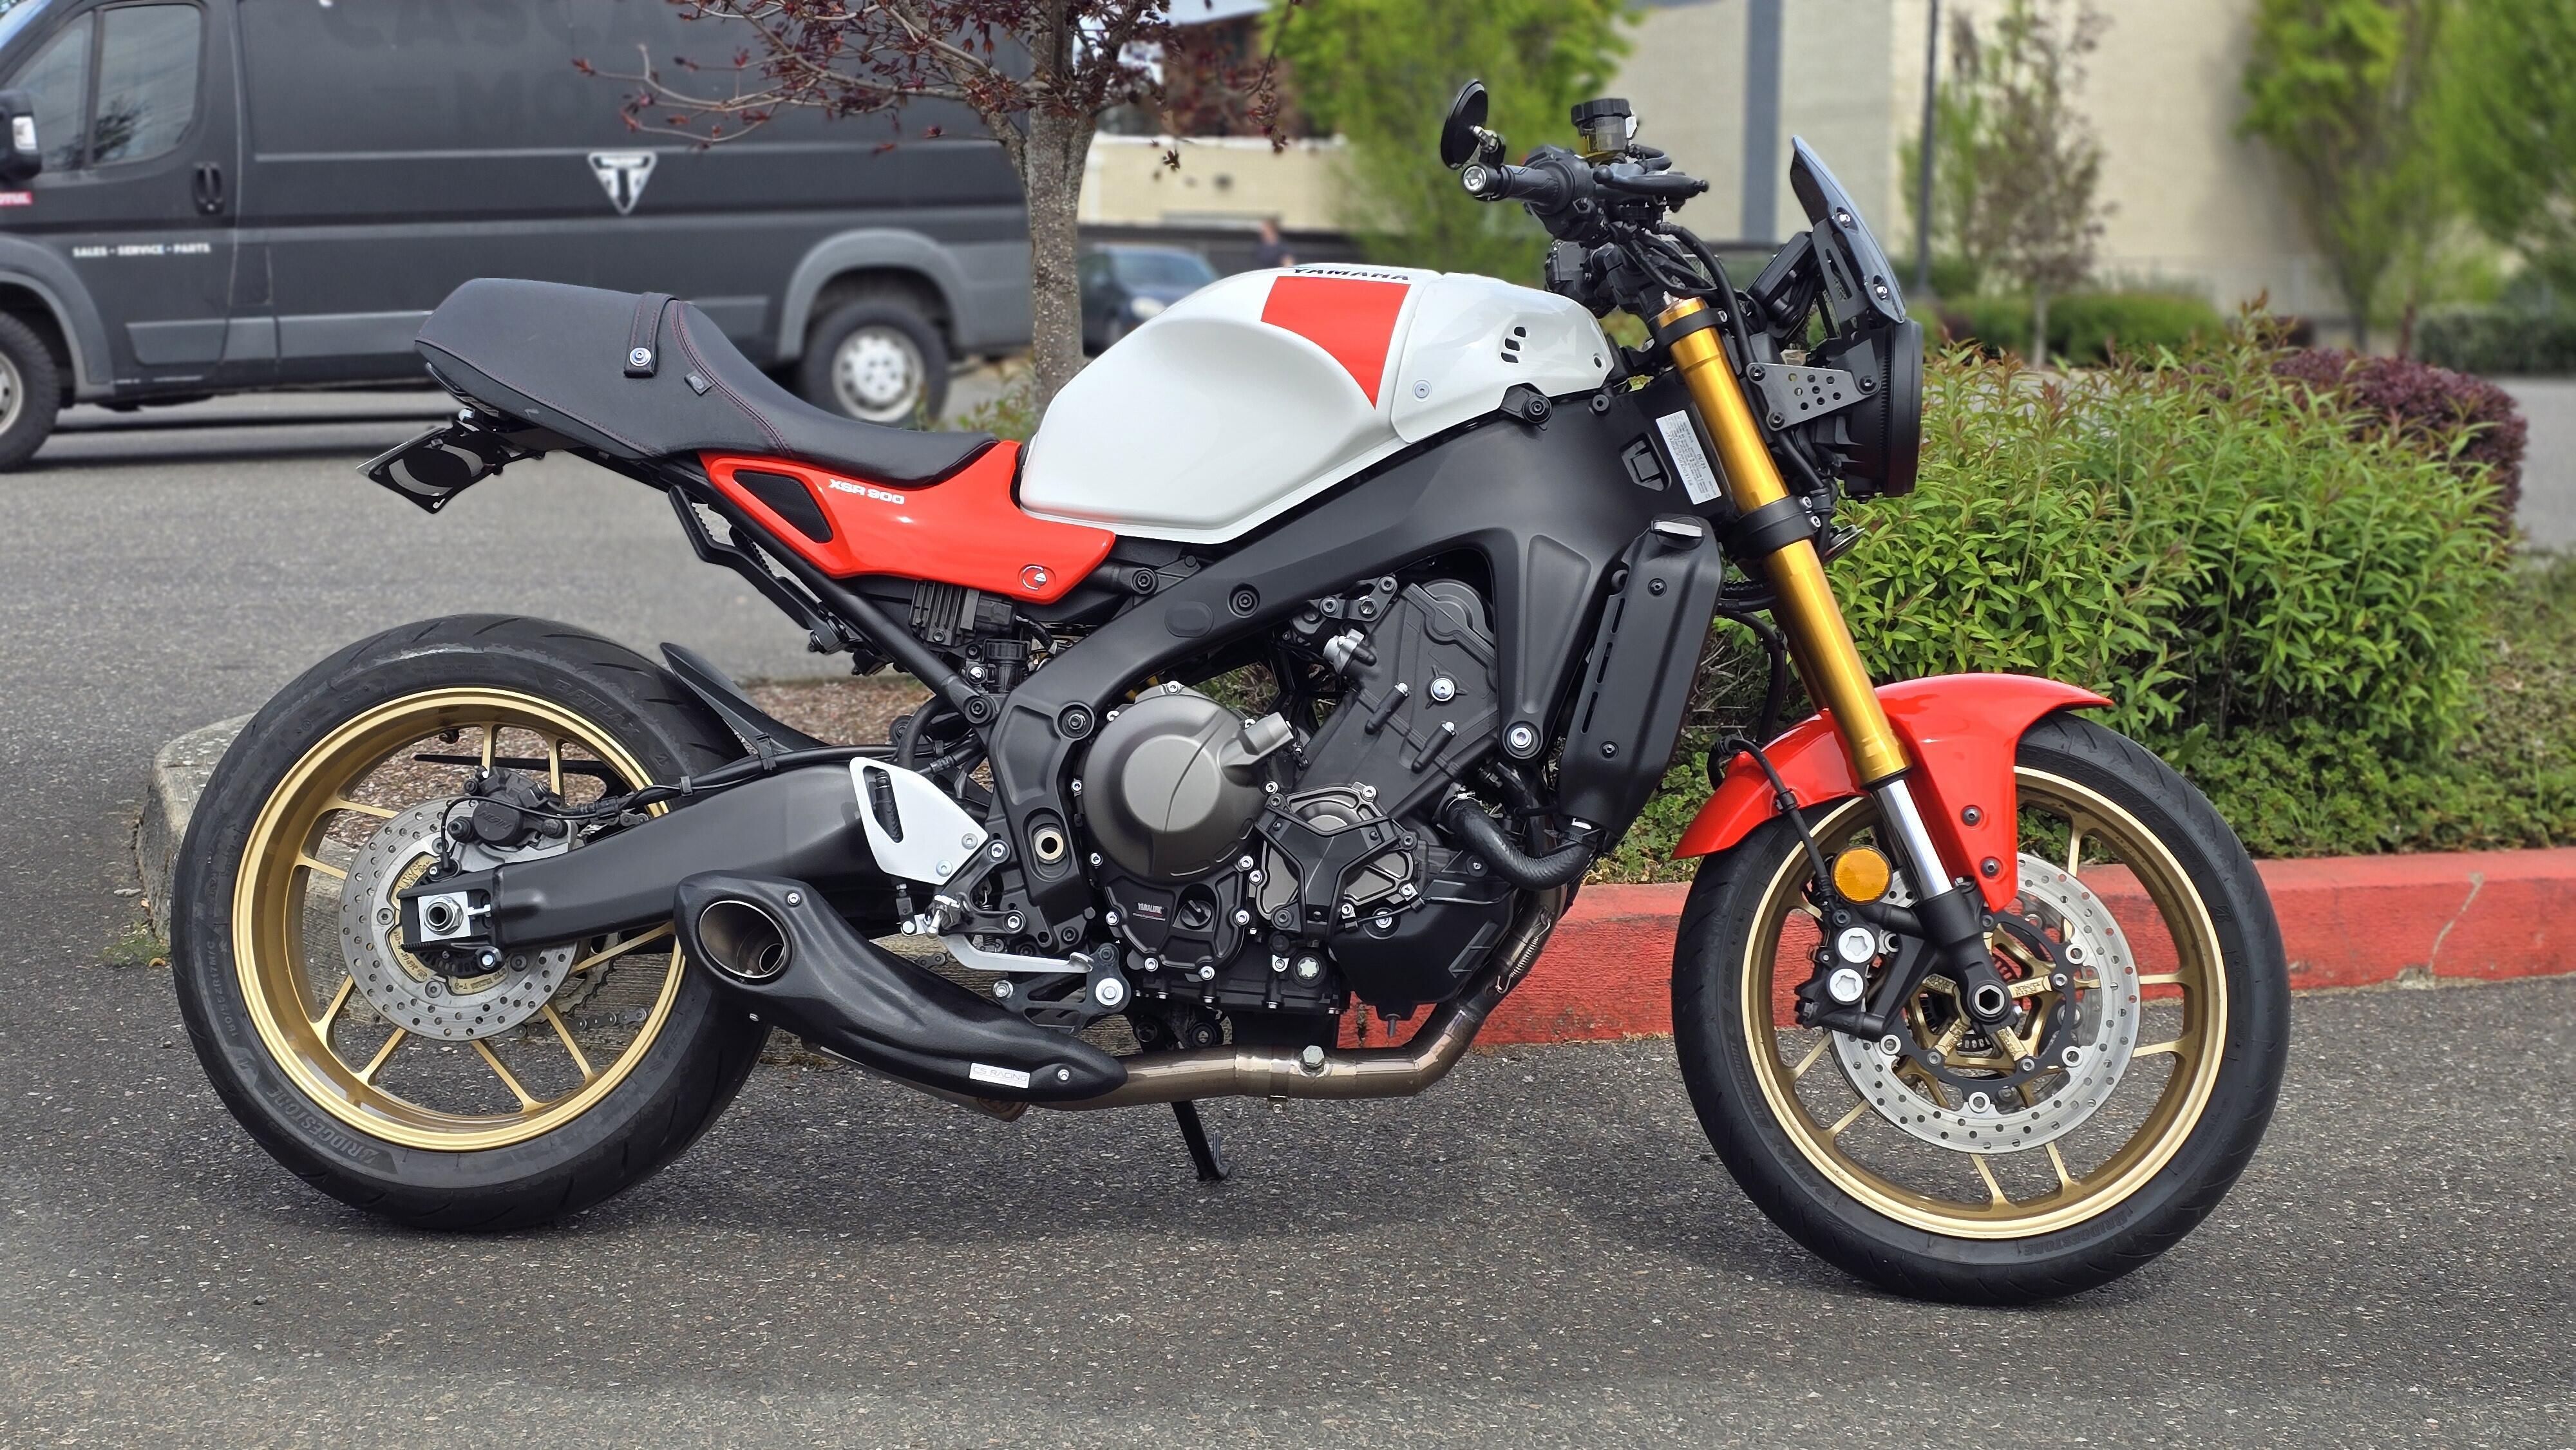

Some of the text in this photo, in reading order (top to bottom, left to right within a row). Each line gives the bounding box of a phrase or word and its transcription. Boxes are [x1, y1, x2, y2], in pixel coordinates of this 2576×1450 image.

[73, 243, 211, 257] SALES SERVICE PARTS
[1294, 268, 1408, 281] YAMAHA
[828, 478, 905, 505] XSR 900
[990, 1069, 1027, 1082] RACING
[266, 1086, 379, 1165] BRIDGESTONE
[2023, 1210, 2129, 1259] BRIDGESTONE
